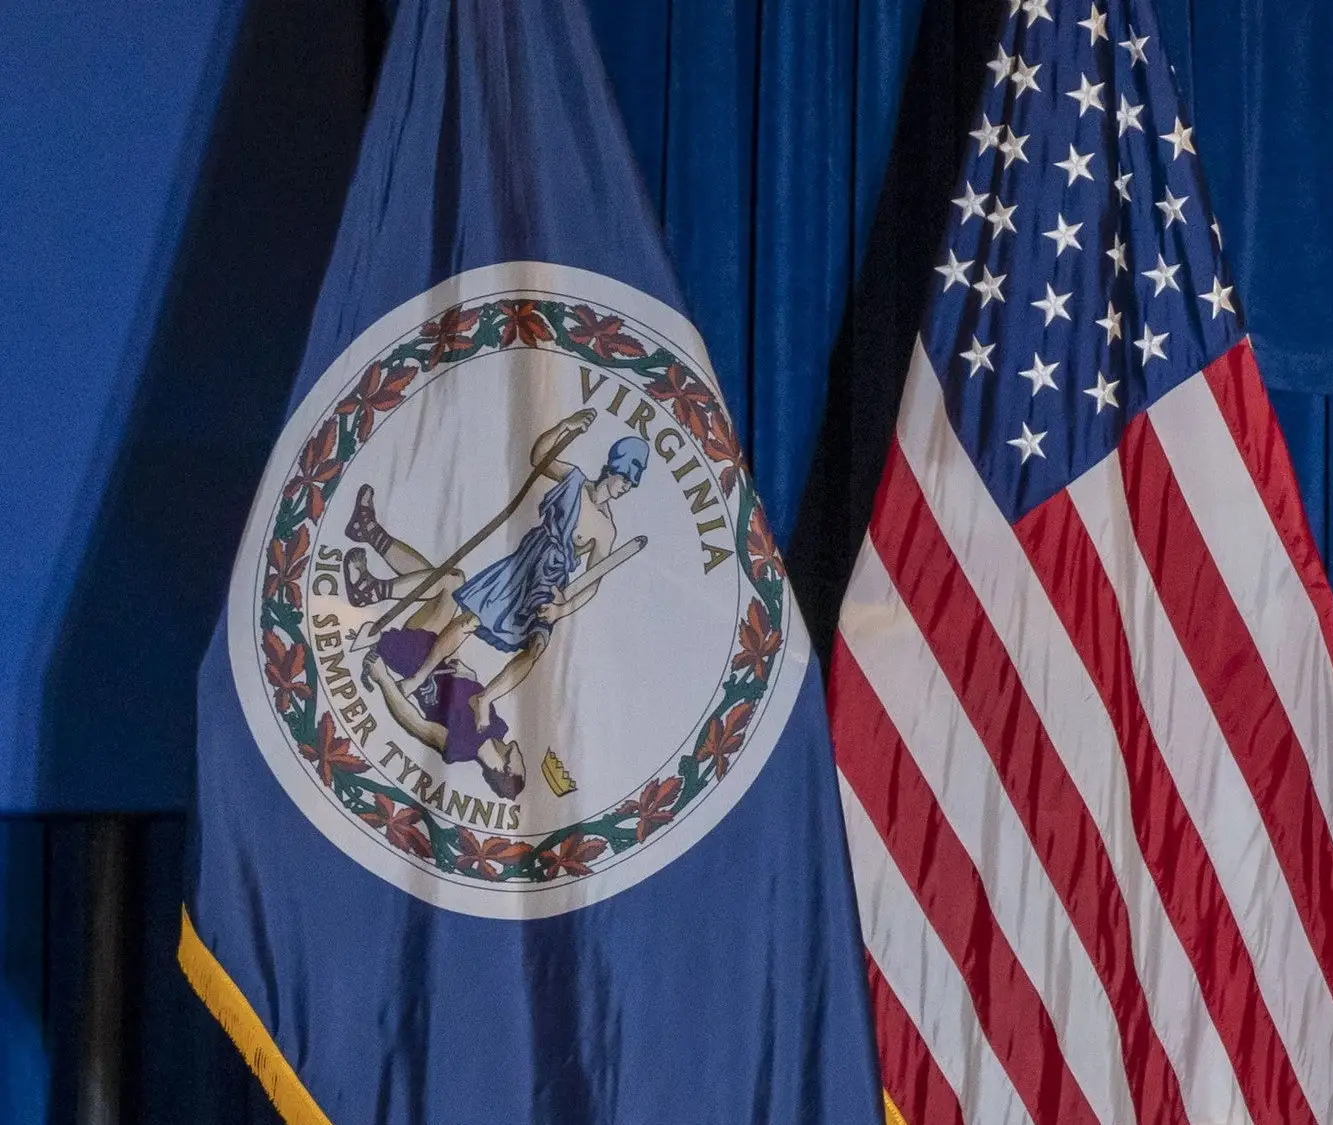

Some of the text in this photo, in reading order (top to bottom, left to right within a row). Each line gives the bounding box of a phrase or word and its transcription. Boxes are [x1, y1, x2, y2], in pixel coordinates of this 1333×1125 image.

[580, 366, 734, 576] VIRGINIA
[311, 543, 521, 830] SIC SEMPER TYRANNIS
